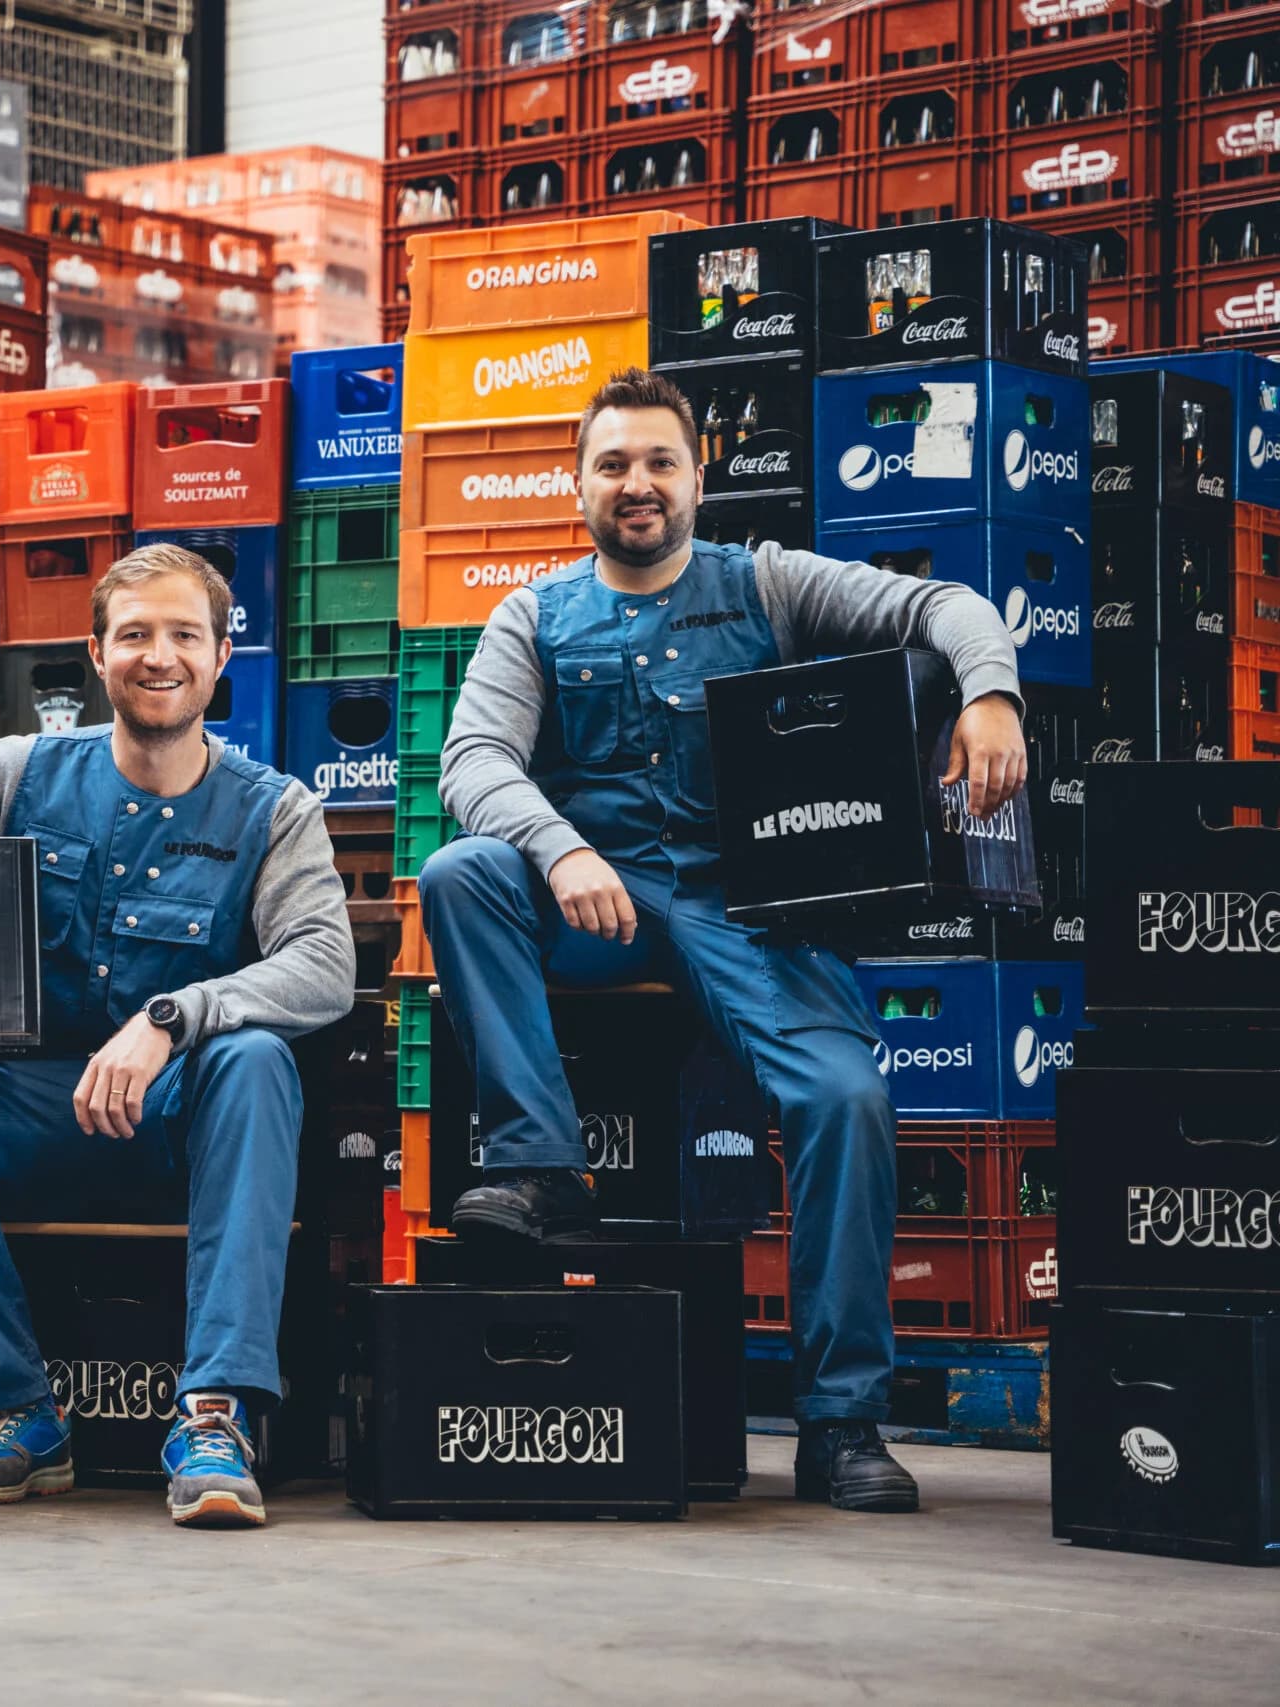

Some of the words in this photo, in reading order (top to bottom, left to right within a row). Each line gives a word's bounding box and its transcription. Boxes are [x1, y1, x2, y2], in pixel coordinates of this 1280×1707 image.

[625, 60, 692, 98] cfp
[1225, 110, 1280, 152] cf
[1030, 143, 1111, 185] cfp
[1224, 282, 1280, 323] cf
[732, 314, 795, 339] Coca-Cola
[902, 317, 968, 344] Coca-Cola
[1044, 330, 1080, 361] Coca-Cola
[473, 337, 591, 396] ORANGINA
[172, 470, 220, 485] sources
[223, 467, 241, 482] de
[728, 450, 790, 476] Coca-Cola
[1031, 450, 1077, 484] pepsi
[163, 485, 248, 503] SOULTZMATT
[461, 466, 578, 500] ORANGIN
[1196, 473, 1224, 498] Coca-Cola
[1032, 605, 1079, 640] pepsi
[1195, 611, 1224, 634] Coca-Cola
[314, 752, 399, 799] grisette
[1050, 777, 1084, 804] Coca-Cola
[752, 815, 777, 840] LE
[778, 801, 883, 836] FOURGON
[1138, 891, 1280, 953] FOURG
[893, 1043, 973, 1072] pepsi
[1041, 1042, 1074, 1073] pep
[346, 1132, 376, 1158] FOURGON
[695, 1135, 705, 1156] LE
[707, 1130, 753, 1156] FOURGON
[1128, 1186, 1280, 1249] FOURG
[1030, 1248, 1057, 1297] cf
[43, 1359, 186, 1420] OURGO
[438, 1406, 624, 1464] FOURGON
